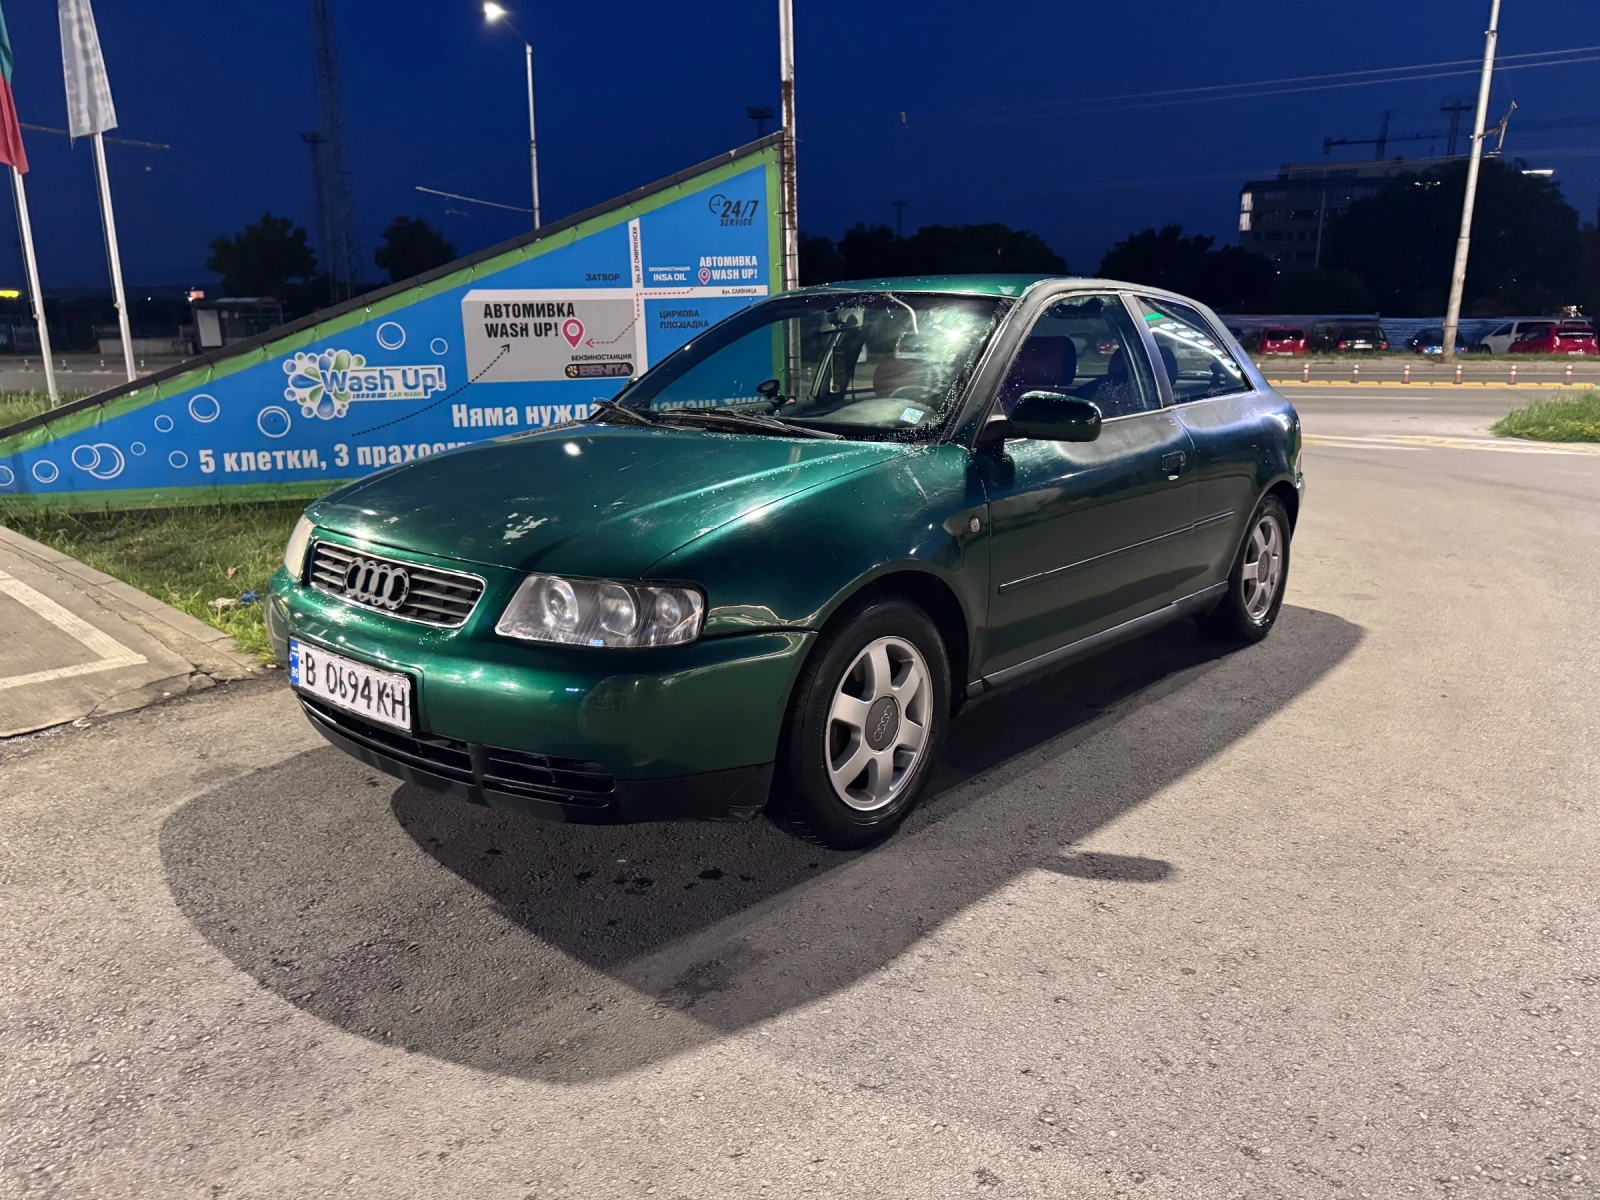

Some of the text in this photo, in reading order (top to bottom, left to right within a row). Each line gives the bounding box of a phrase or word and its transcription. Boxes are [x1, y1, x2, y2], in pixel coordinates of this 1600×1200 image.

[721, 200, 759, 218] 24/7
[720, 218, 752, 226] SERVICE
[700, 256, 758, 267] АВТОМИВКА
[586, 273, 620, 281] ЗАТВОР
[674, 273, 687, 281] OIL
[712, 269, 758, 280] WASH UP!
[484, 302, 576, 319] АВТОМИВКА
[659, 309, 699, 319] ЦИРКОВА
[485, 322, 559, 338] WASH UP!
[659, 320, 709, 329] ПЛОЩАДКА
[571, 353, 632, 361] БЕНЗИНОСТАНЦИЯ
[579, 364, 631, 376] BENITA
[320, 367, 445, 397] Wash Up!
[452, 404, 518, 428] Няма
[199, 449, 216, 474] 5
[223, 448, 327, 473] клетки,
[333, 443, 349, 467] 3
[305, 651, 316, 687] B
[326, 661, 373, 710] 0694
